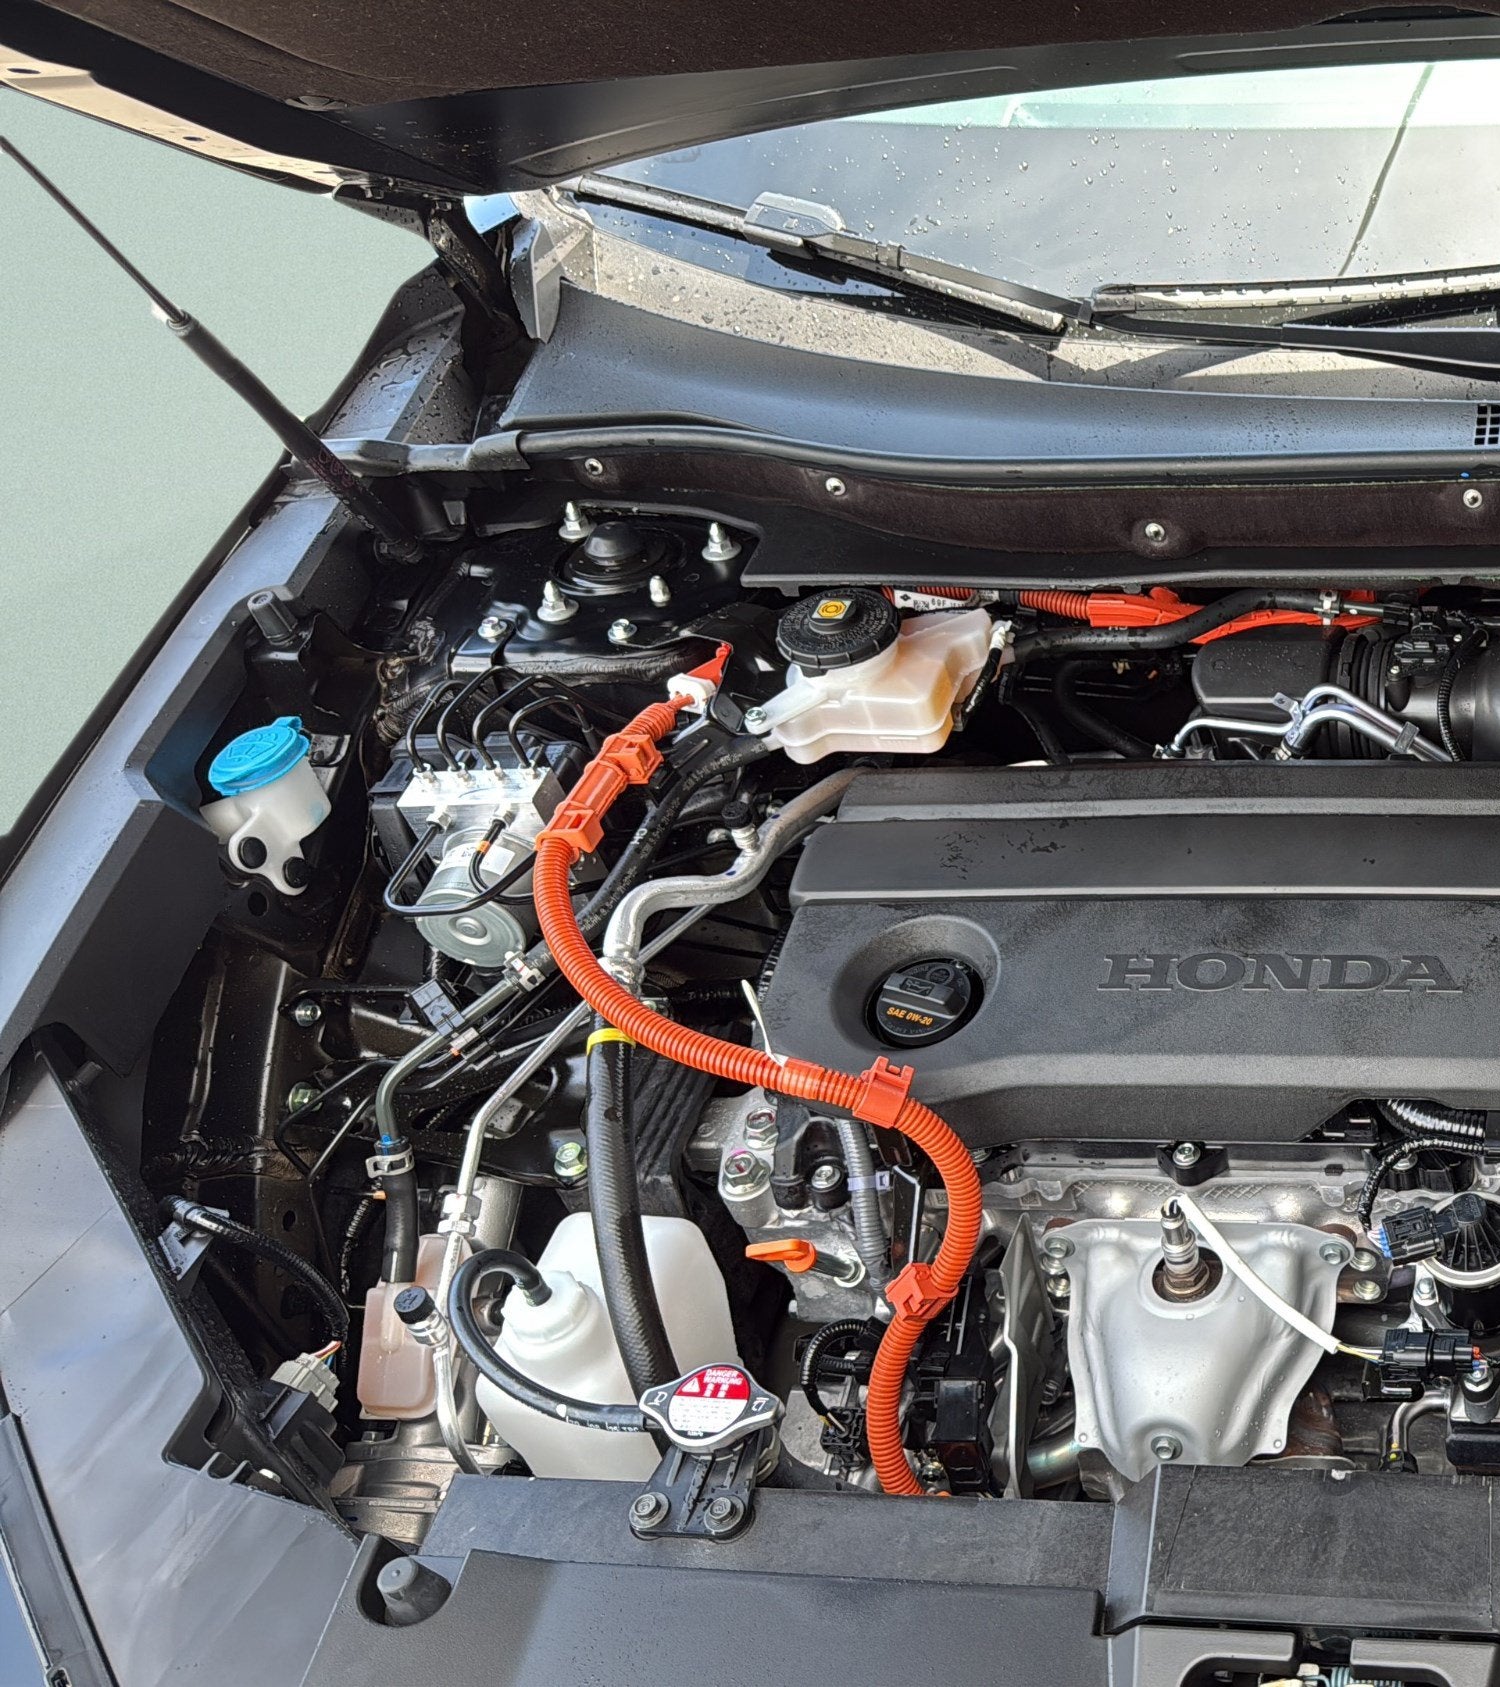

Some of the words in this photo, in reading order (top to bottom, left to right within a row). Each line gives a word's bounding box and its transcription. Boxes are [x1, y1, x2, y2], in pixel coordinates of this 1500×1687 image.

[1097, 953, 1463, 993] HONDA
[886, 1007, 906, 1018] SAE
[906, 1012, 933, 1025] 0W-20
